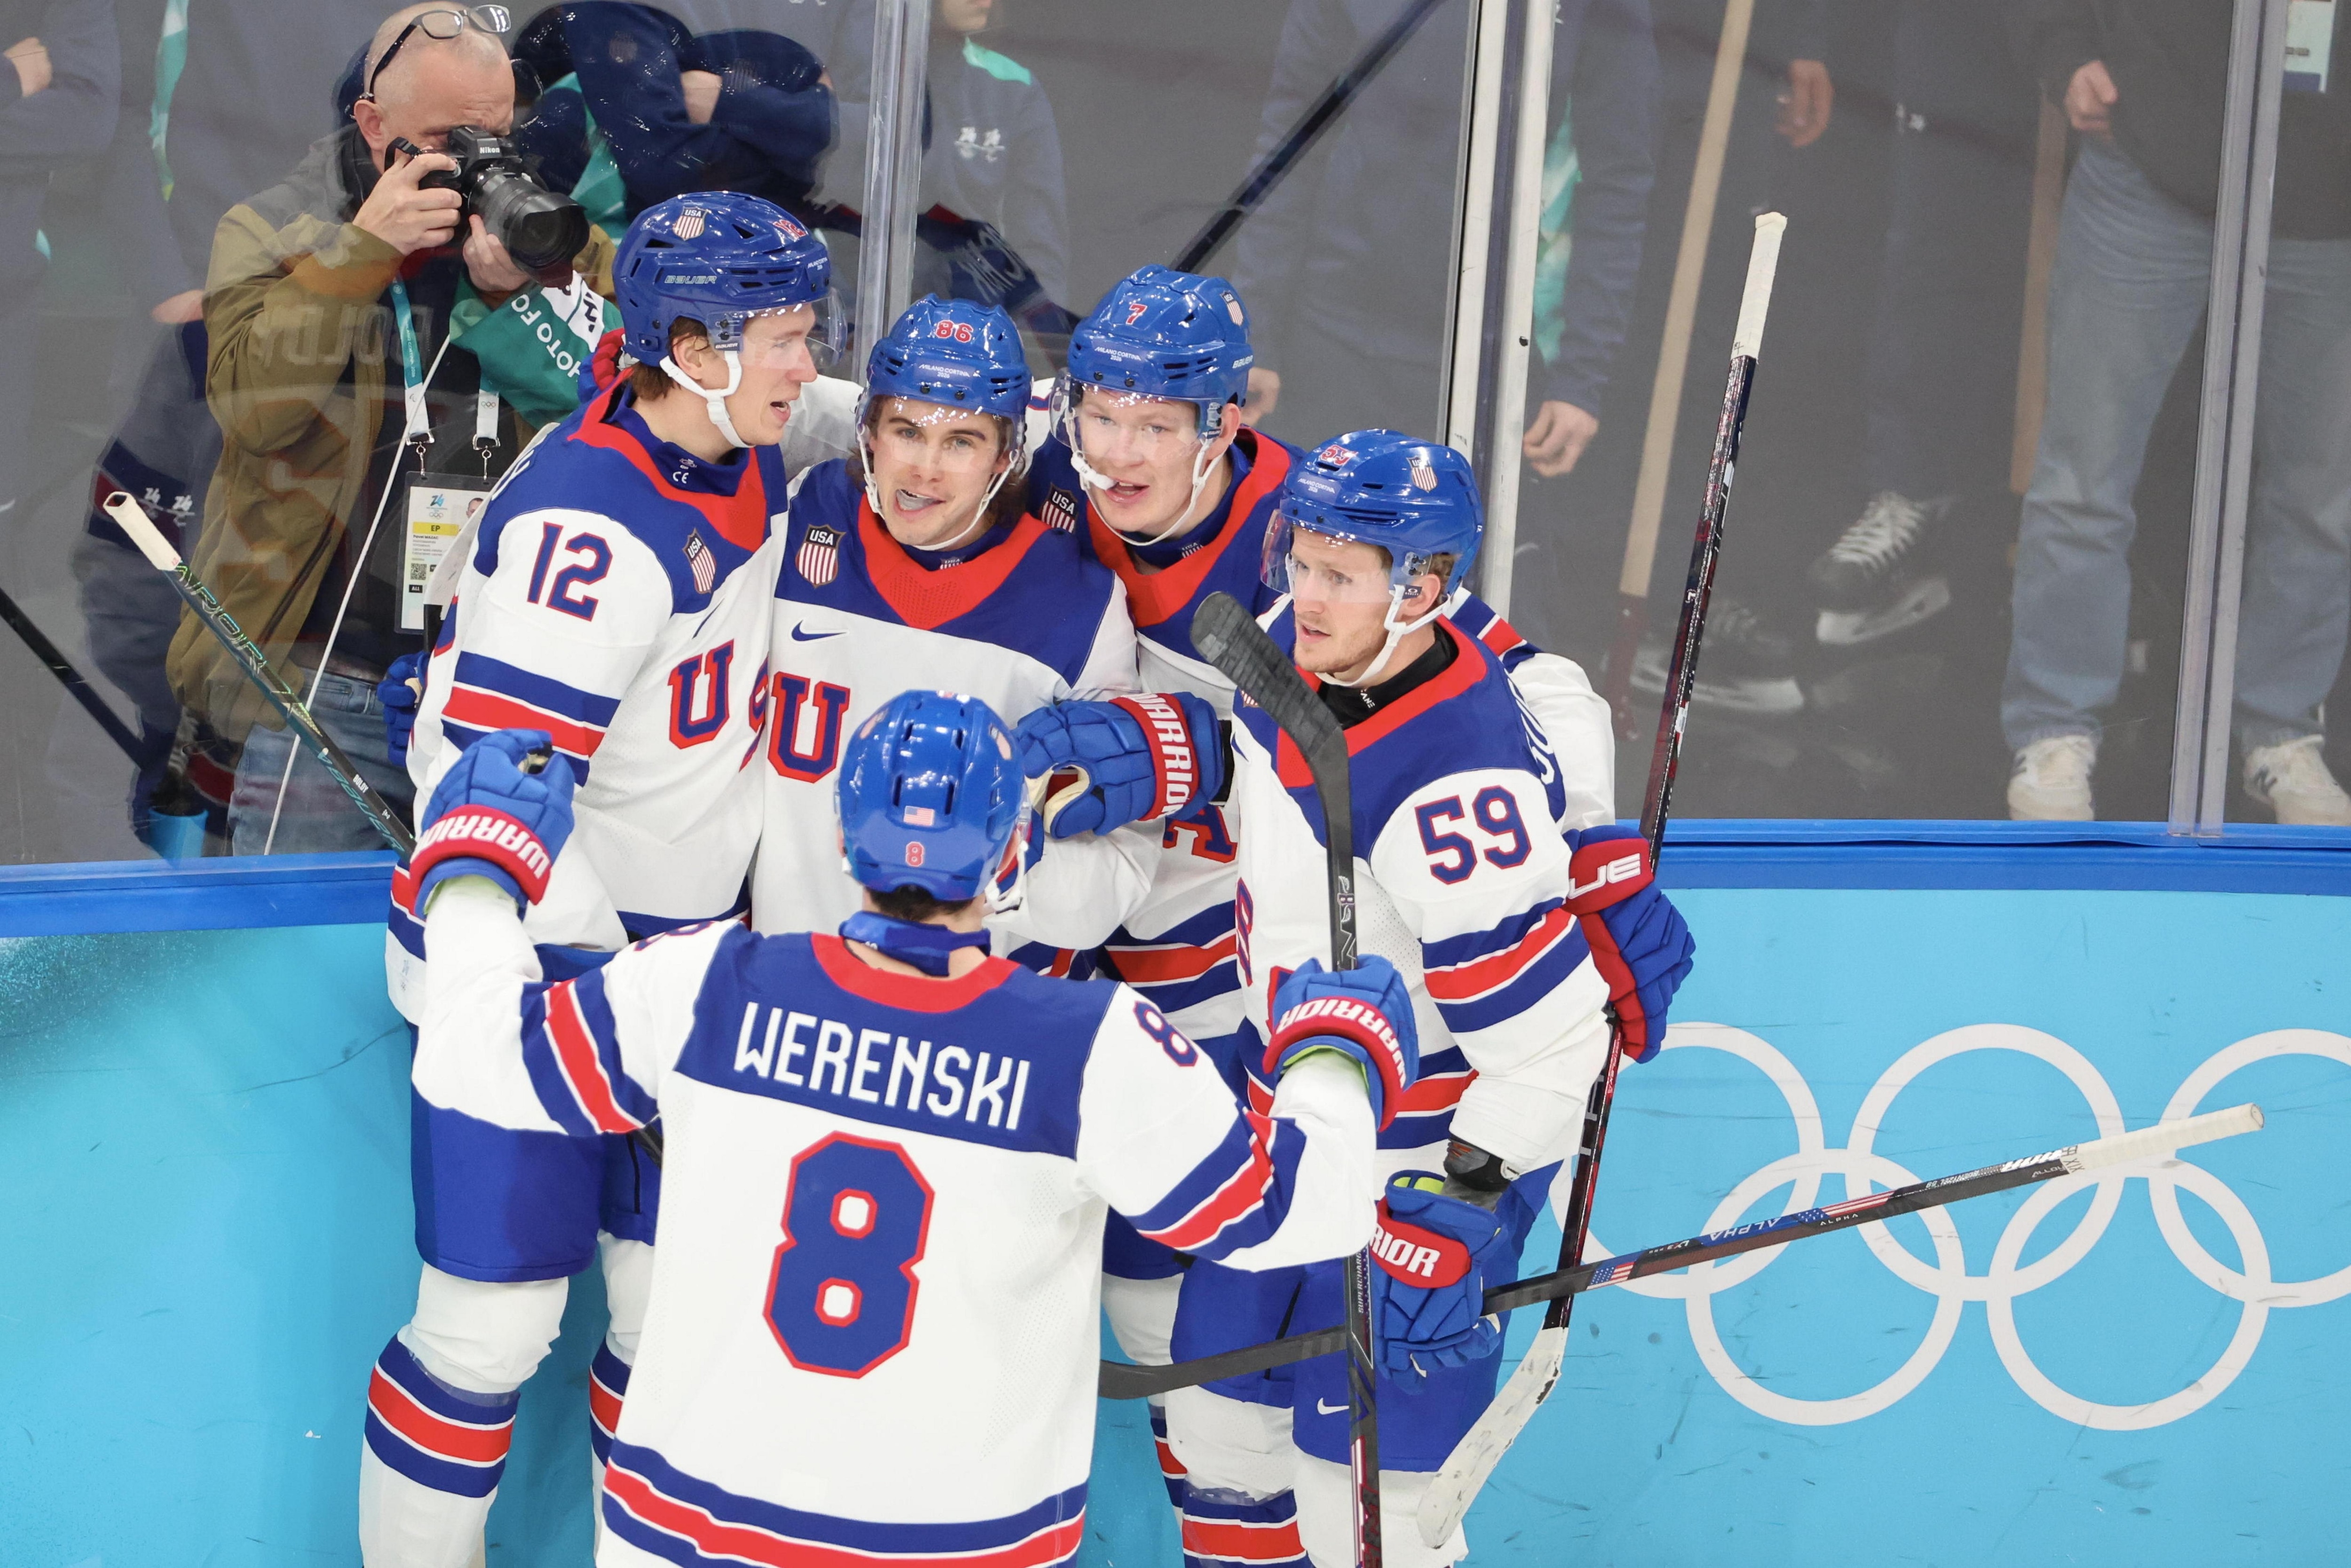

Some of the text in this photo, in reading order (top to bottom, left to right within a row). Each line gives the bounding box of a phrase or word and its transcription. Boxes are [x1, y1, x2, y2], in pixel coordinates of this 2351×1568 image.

[773, 220, 807, 238] 12
[664, 275, 717, 284] BAUER
[1126, 303, 1148, 325] 7
[935, 320, 973, 343] 86
[536, 323, 582, 378] HOTO
[1095, 347, 1141, 361] MILANO CORTINA
[944, 368, 970, 377] CORTINA
[672, 472, 689, 484] CE
[1298, 478, 1335, 493] MILANO CORTINA
[1052, 490, 1075, 515] USA
[687, 537, 702, 558] USA
[809, 529, 835, 545] USA
[527, 521, 613, 622] 12
[353, 774, 369, 793] BOLDY
[1414, 785, 1532, 885] 59
[905, 841, 924, 867] 8
[1567, 853, 1641, 899] UE
[1134, 999, 1199, 1067] 8
[733, 1001, 1030, 1130] WERENSKI
[1710, 1217, 1783, 1241] ALPHA
[1820, 1213, 1859, 1226] ALPHA
[762, 1130, 935, 1379] 8
[1370, 1223, 1441, 1277] RIOR
